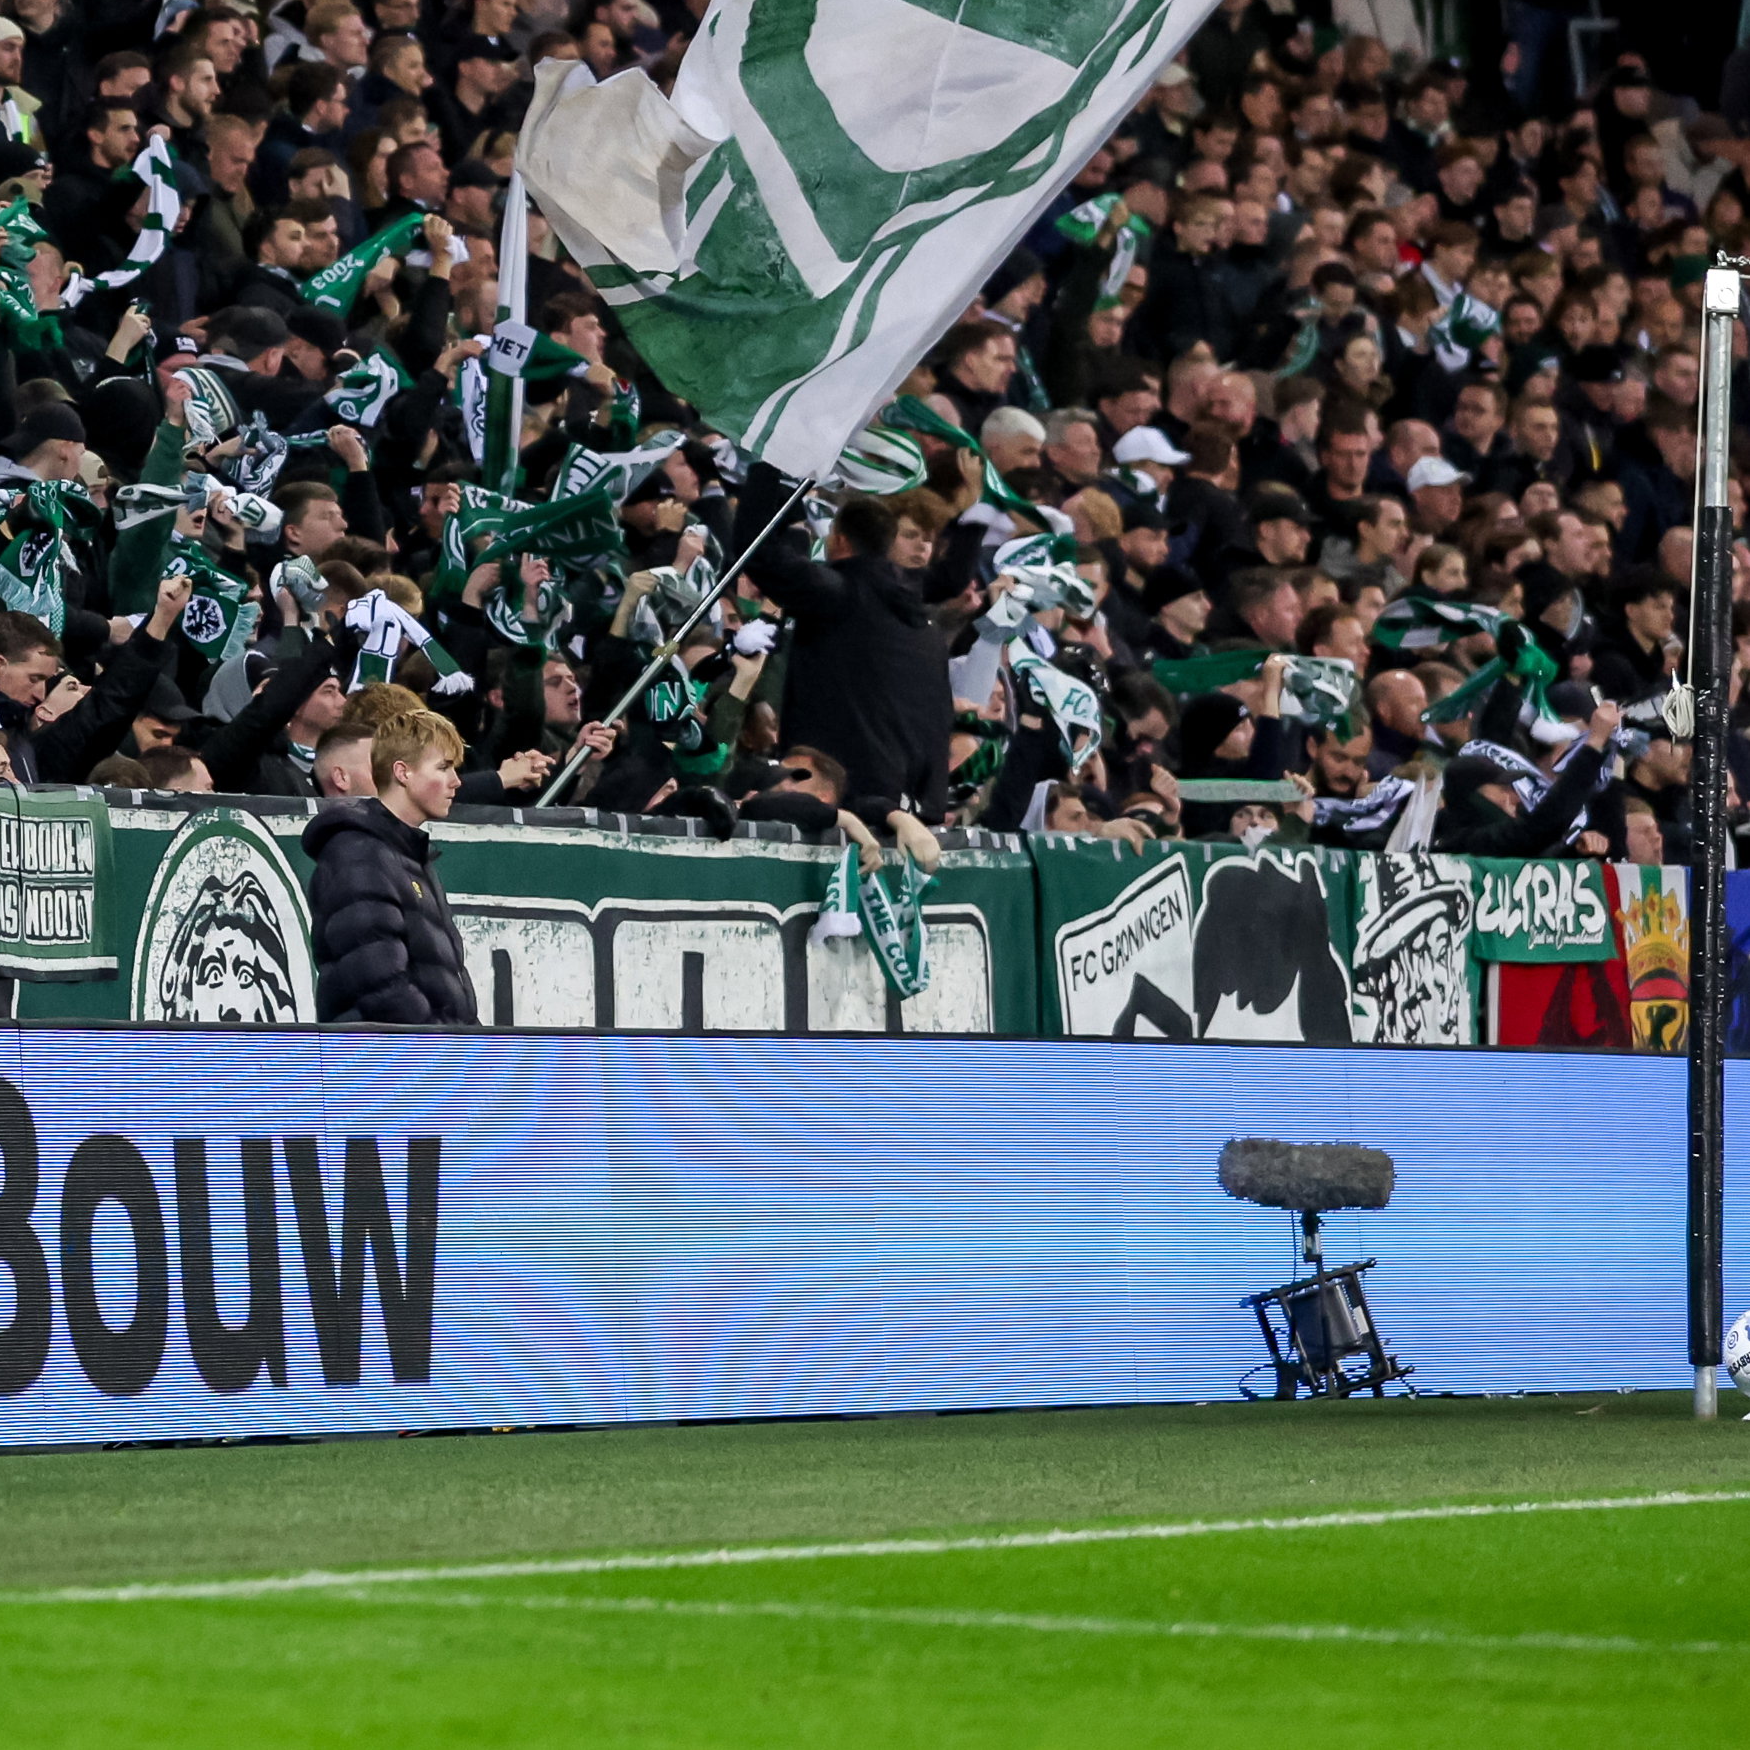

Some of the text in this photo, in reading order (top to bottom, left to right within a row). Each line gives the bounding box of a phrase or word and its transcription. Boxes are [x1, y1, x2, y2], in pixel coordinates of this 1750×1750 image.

[865, 887, 896, 937] THE
[1475, 861, 1606, 938] ULTRAS
[1070, 952, 1099, 992] FC
[1100, 893, 1184, 977] GRONINGEN
